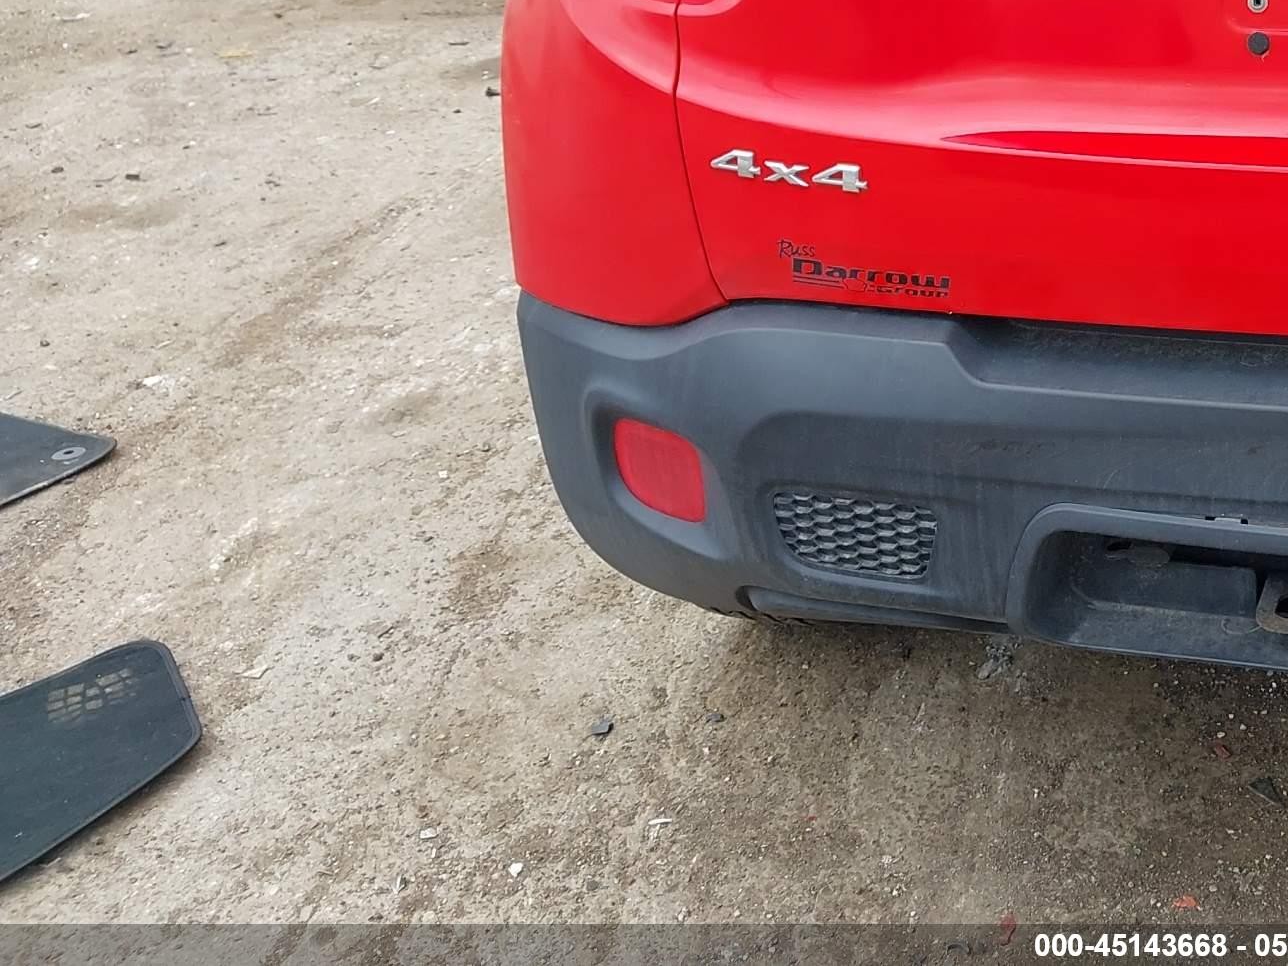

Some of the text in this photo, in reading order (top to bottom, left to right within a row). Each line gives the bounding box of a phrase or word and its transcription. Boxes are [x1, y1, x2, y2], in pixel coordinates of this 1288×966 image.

[710, 149, 868, 193] 4x4
[777, 239, 816, 258] Russ
[793, 258, 951, 289] Darrow
